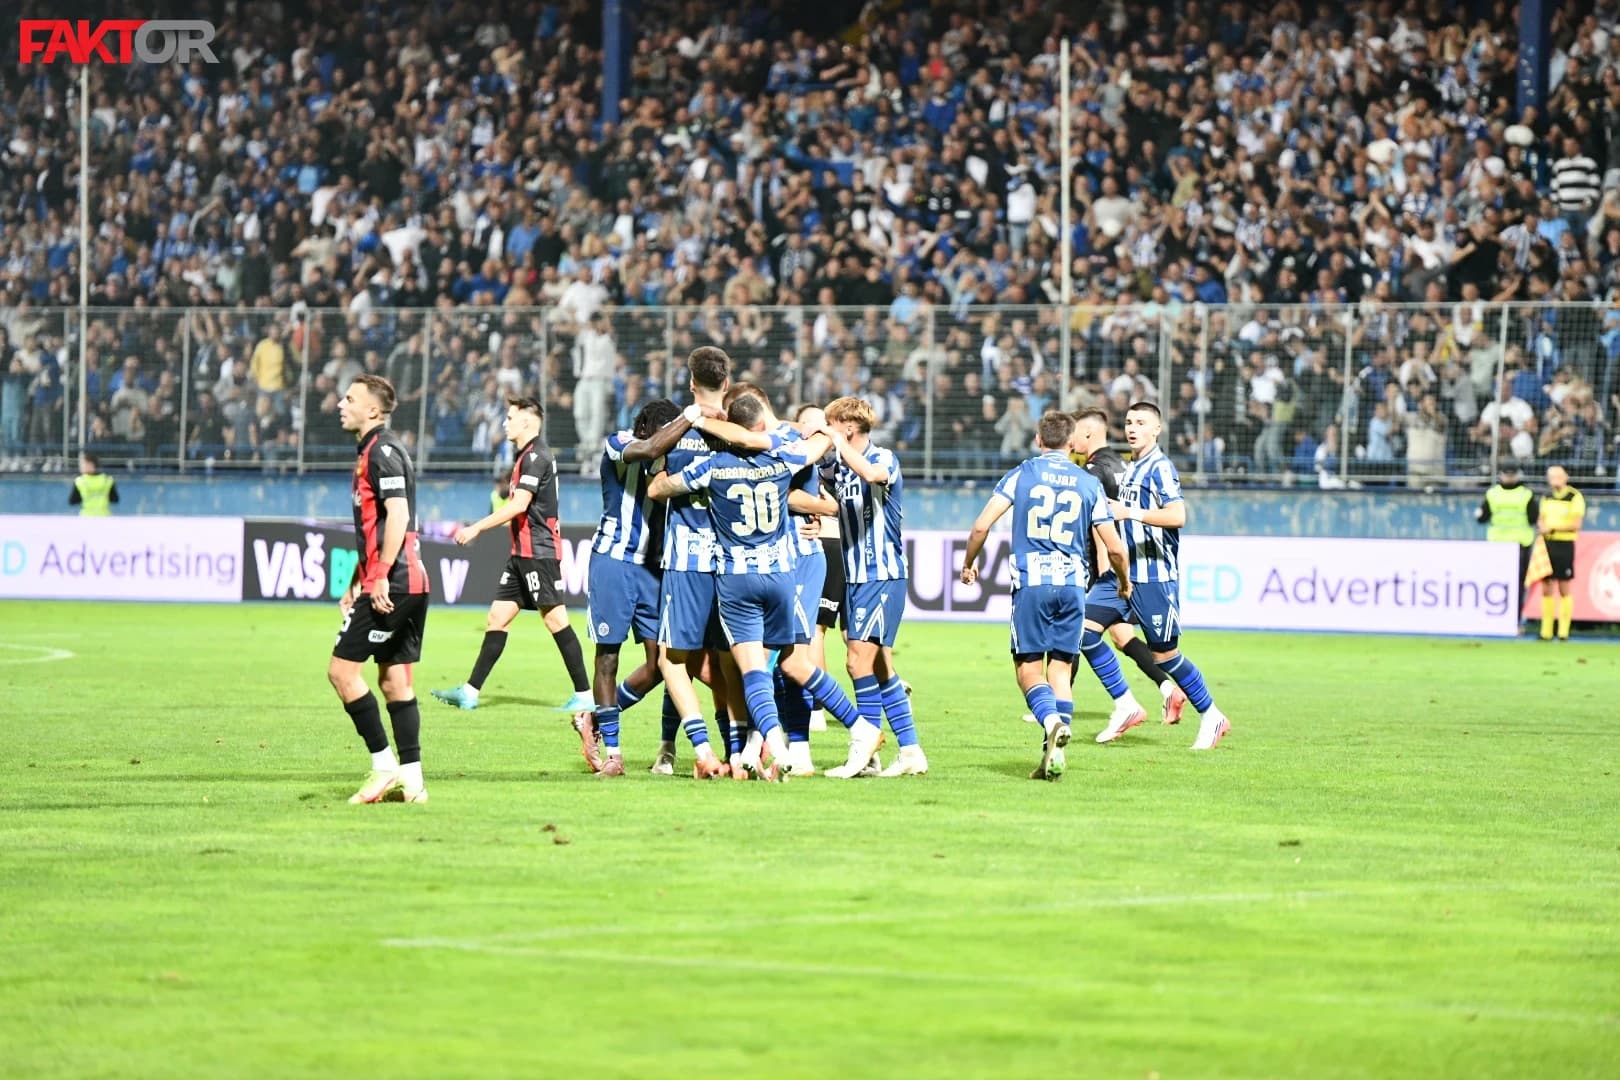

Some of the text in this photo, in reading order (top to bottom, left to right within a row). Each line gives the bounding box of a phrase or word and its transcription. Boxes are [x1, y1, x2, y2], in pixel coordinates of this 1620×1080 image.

[726, 481, 780, 537] 30
[1027, 484, 1083, 546] 22
[2, 541, 237, 583] D Advertising
[253, 532, 326, 599] VAŠ
[525, 571, 541, 592] 18
[1258, 568, 1510, 616] Advertising
